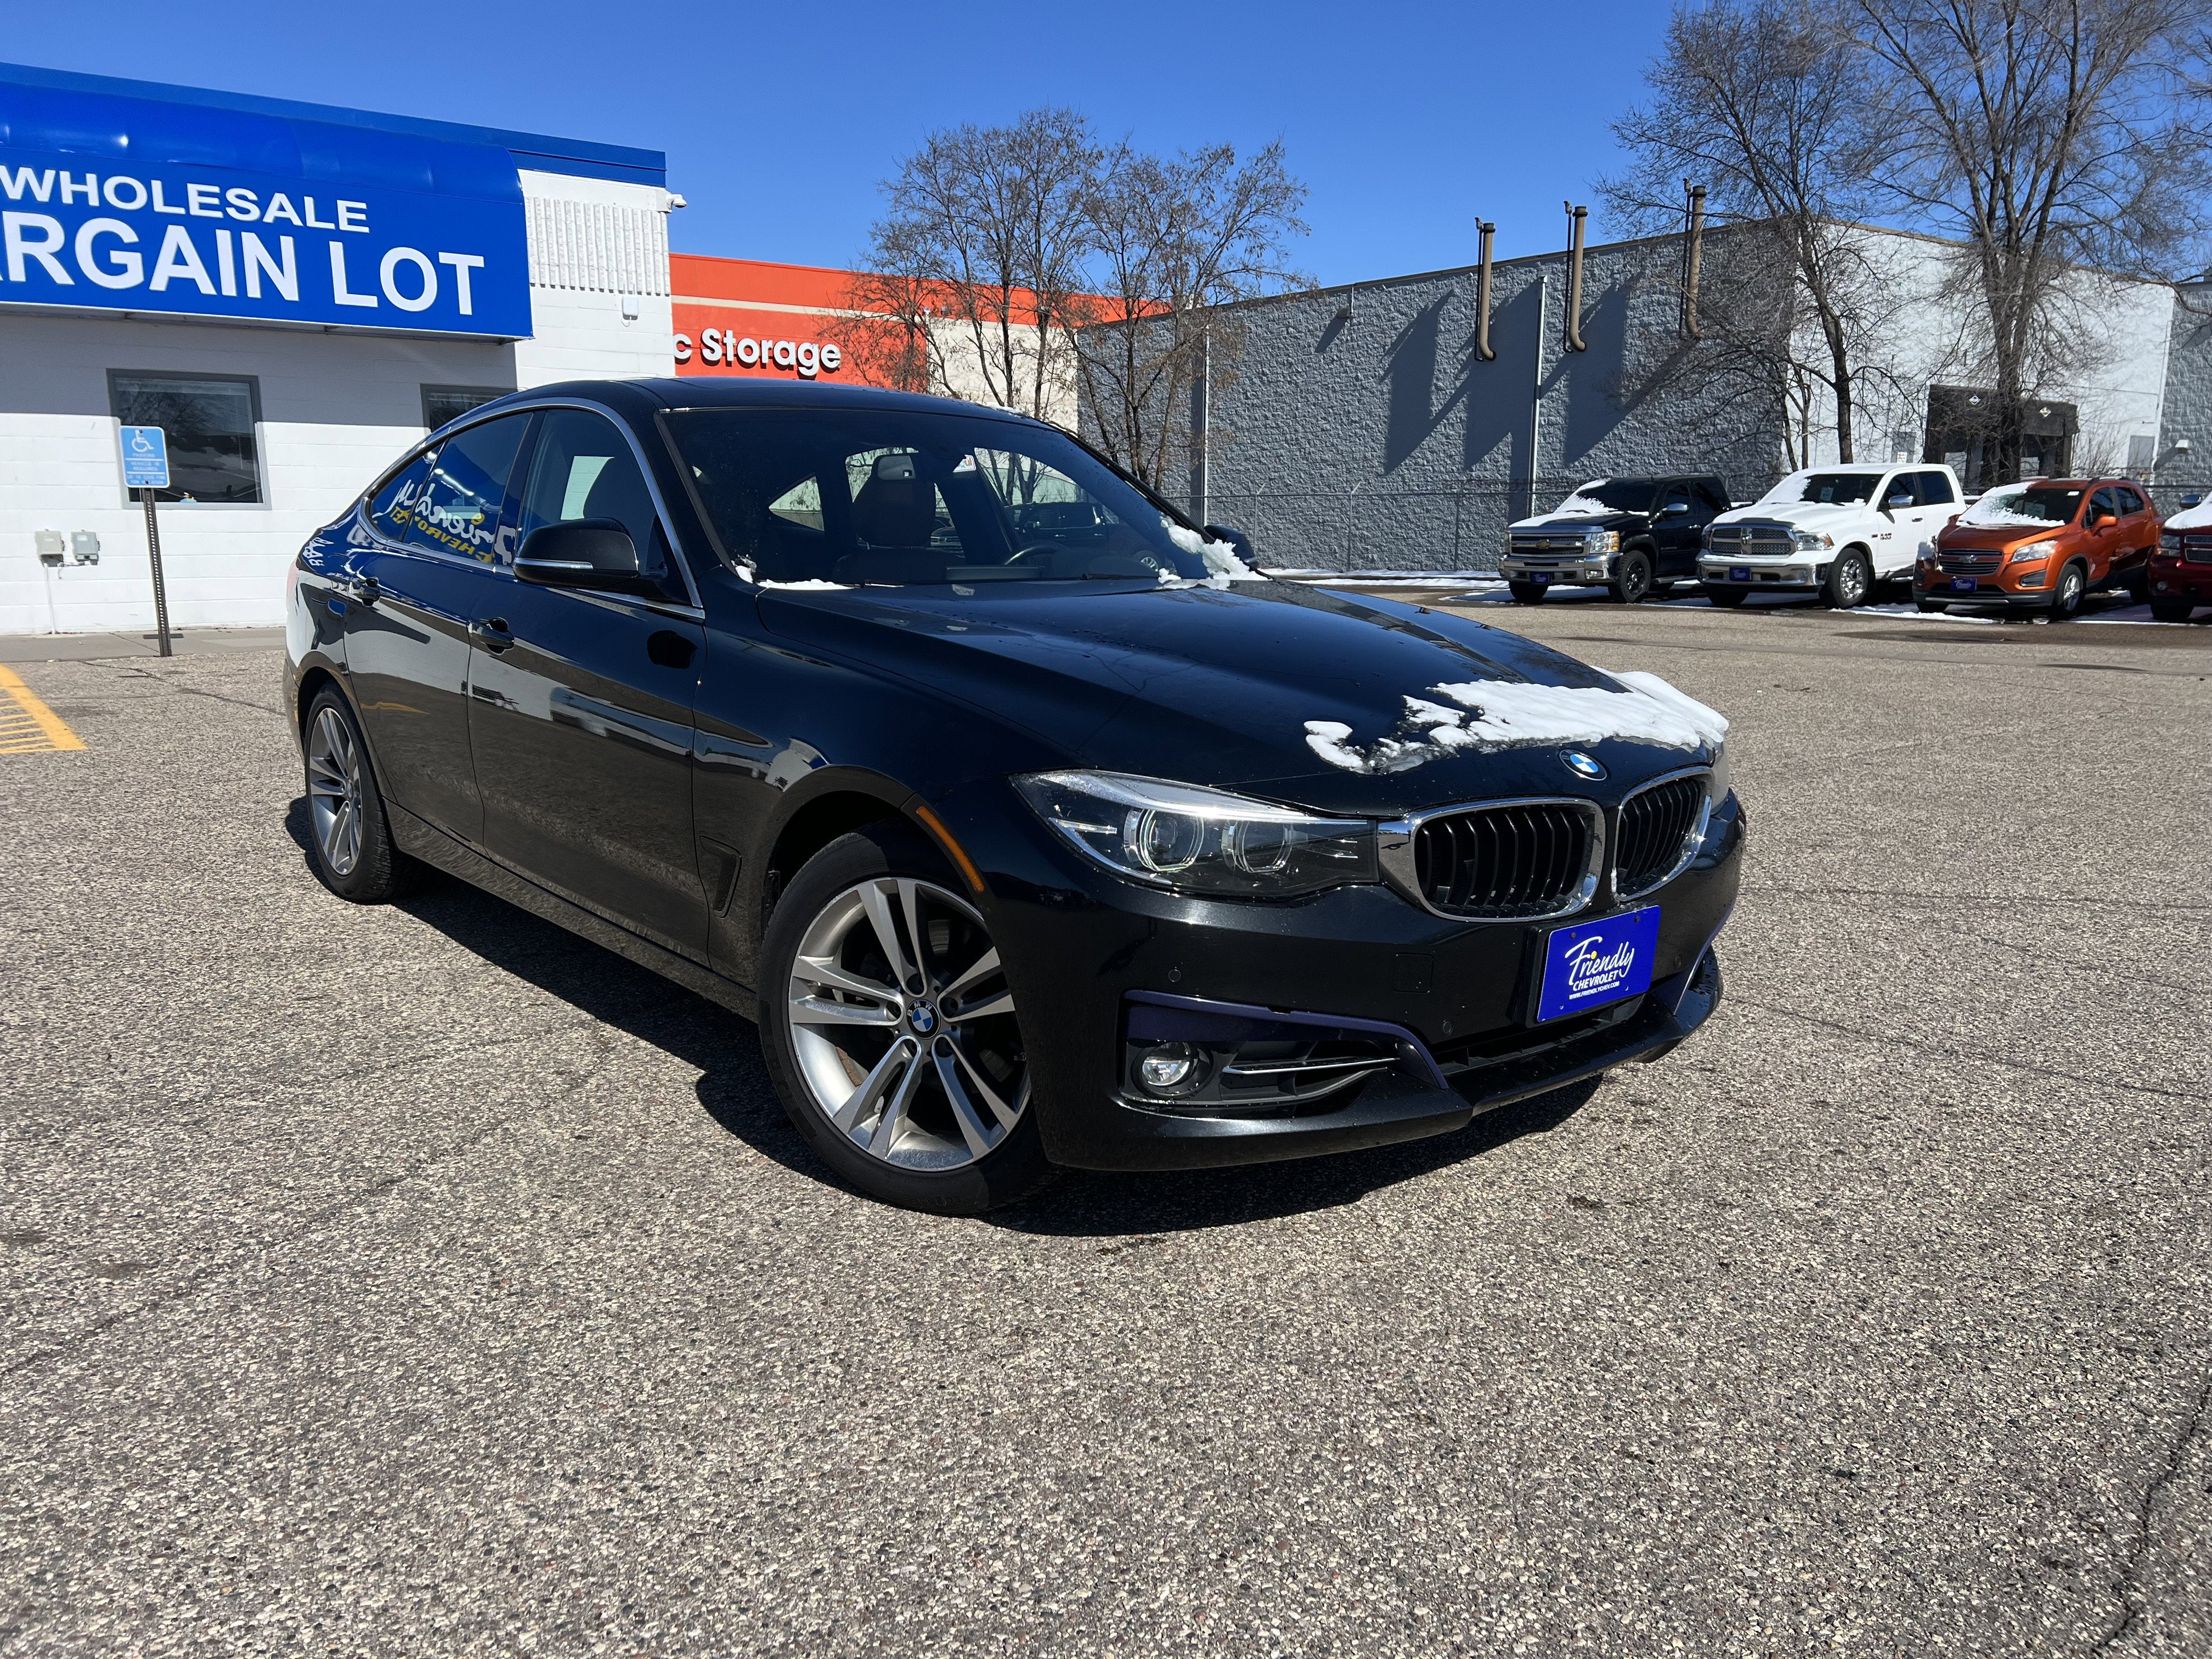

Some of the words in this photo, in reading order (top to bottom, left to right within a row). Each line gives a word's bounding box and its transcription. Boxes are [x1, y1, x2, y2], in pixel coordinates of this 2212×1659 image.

[0, 165, 370, 233] WHOLESALE
[0, 210, 300, 301] RGAIN
[329, 240, 484, 315] LOT
[701, 328, 841, 376] Storage
[1565, 936, 1635, 986] Friendly
[1573, 970, 1619, 991] CHEVROLET
[907, 1001, 933, 1017] BMW
